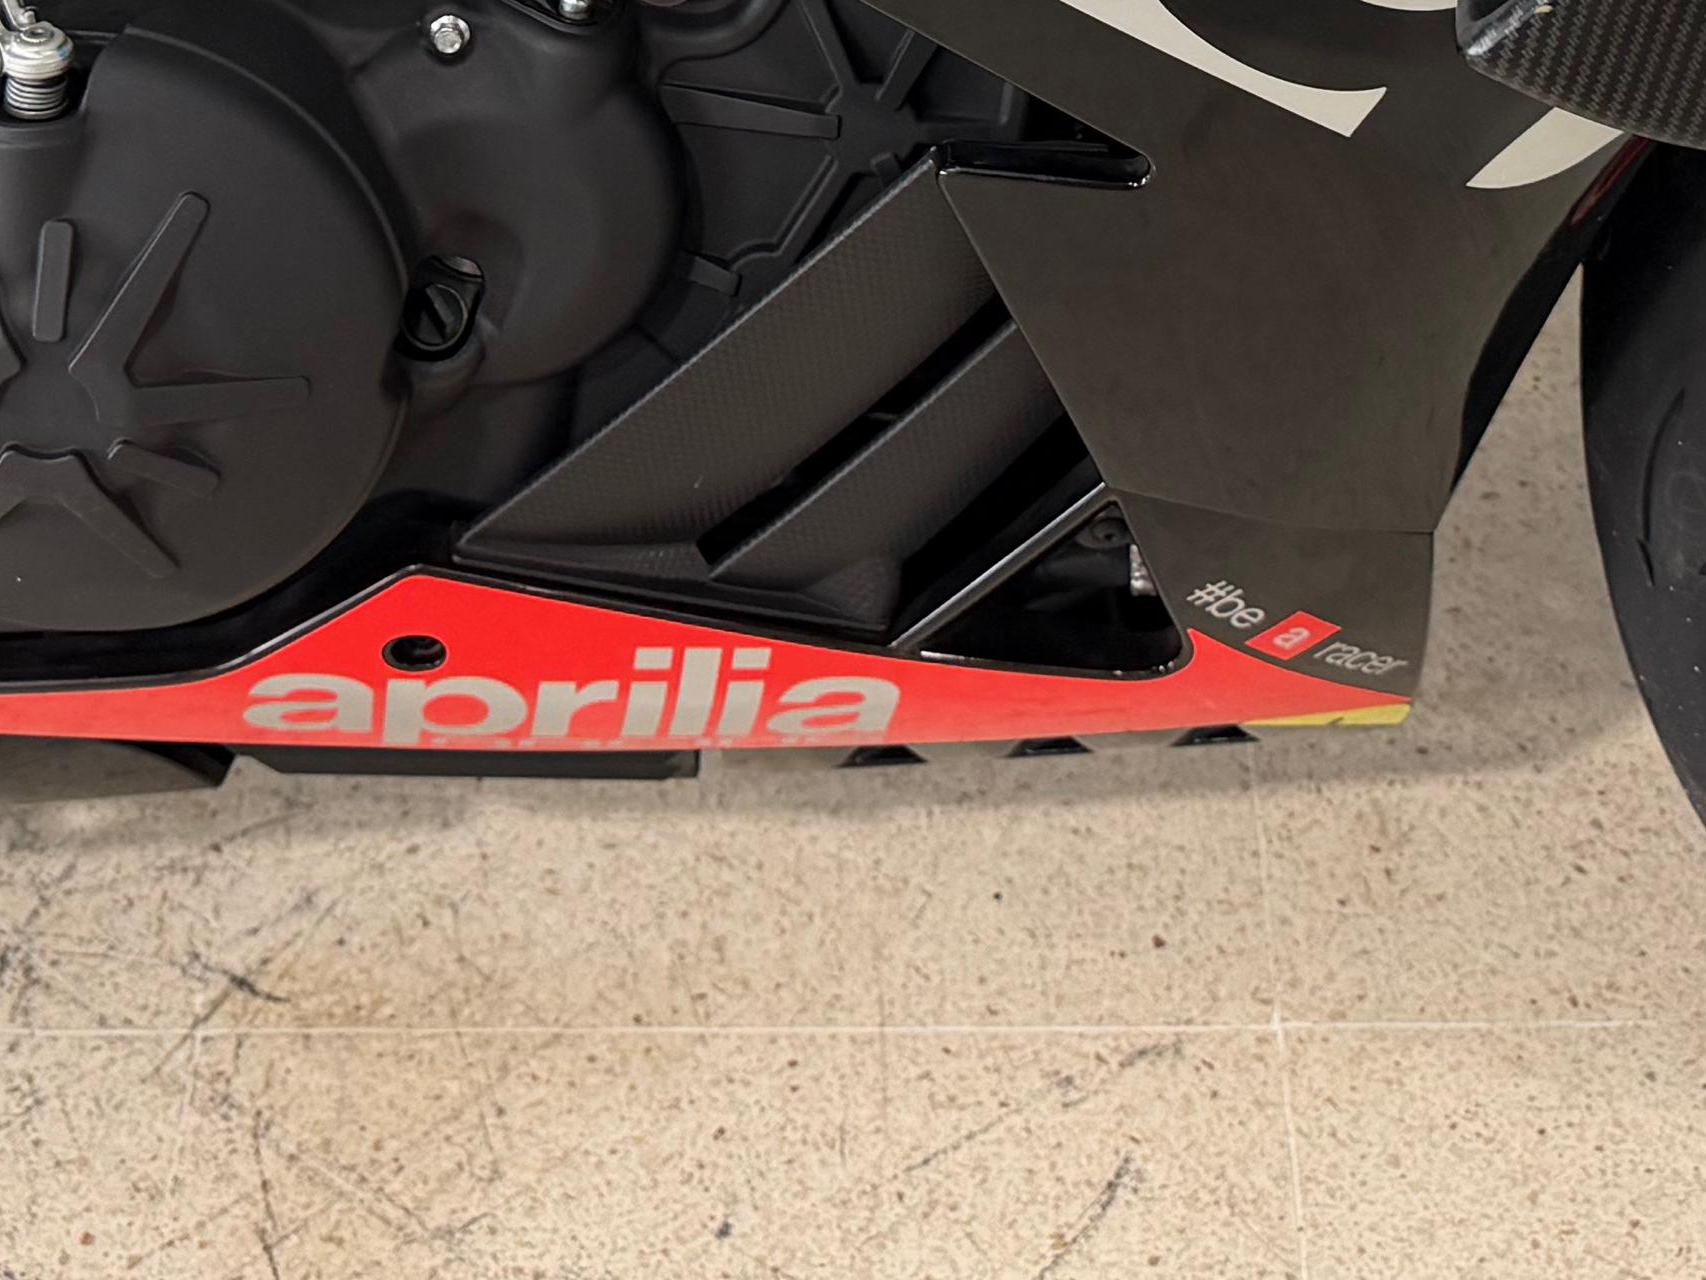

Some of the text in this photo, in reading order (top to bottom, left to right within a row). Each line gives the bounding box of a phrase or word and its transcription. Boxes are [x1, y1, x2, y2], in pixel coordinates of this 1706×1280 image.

[1186, 579, 1265, 629] #be
[1312, 640, 1409, 676] racer
[241, 646, 901, 749] aprilia
